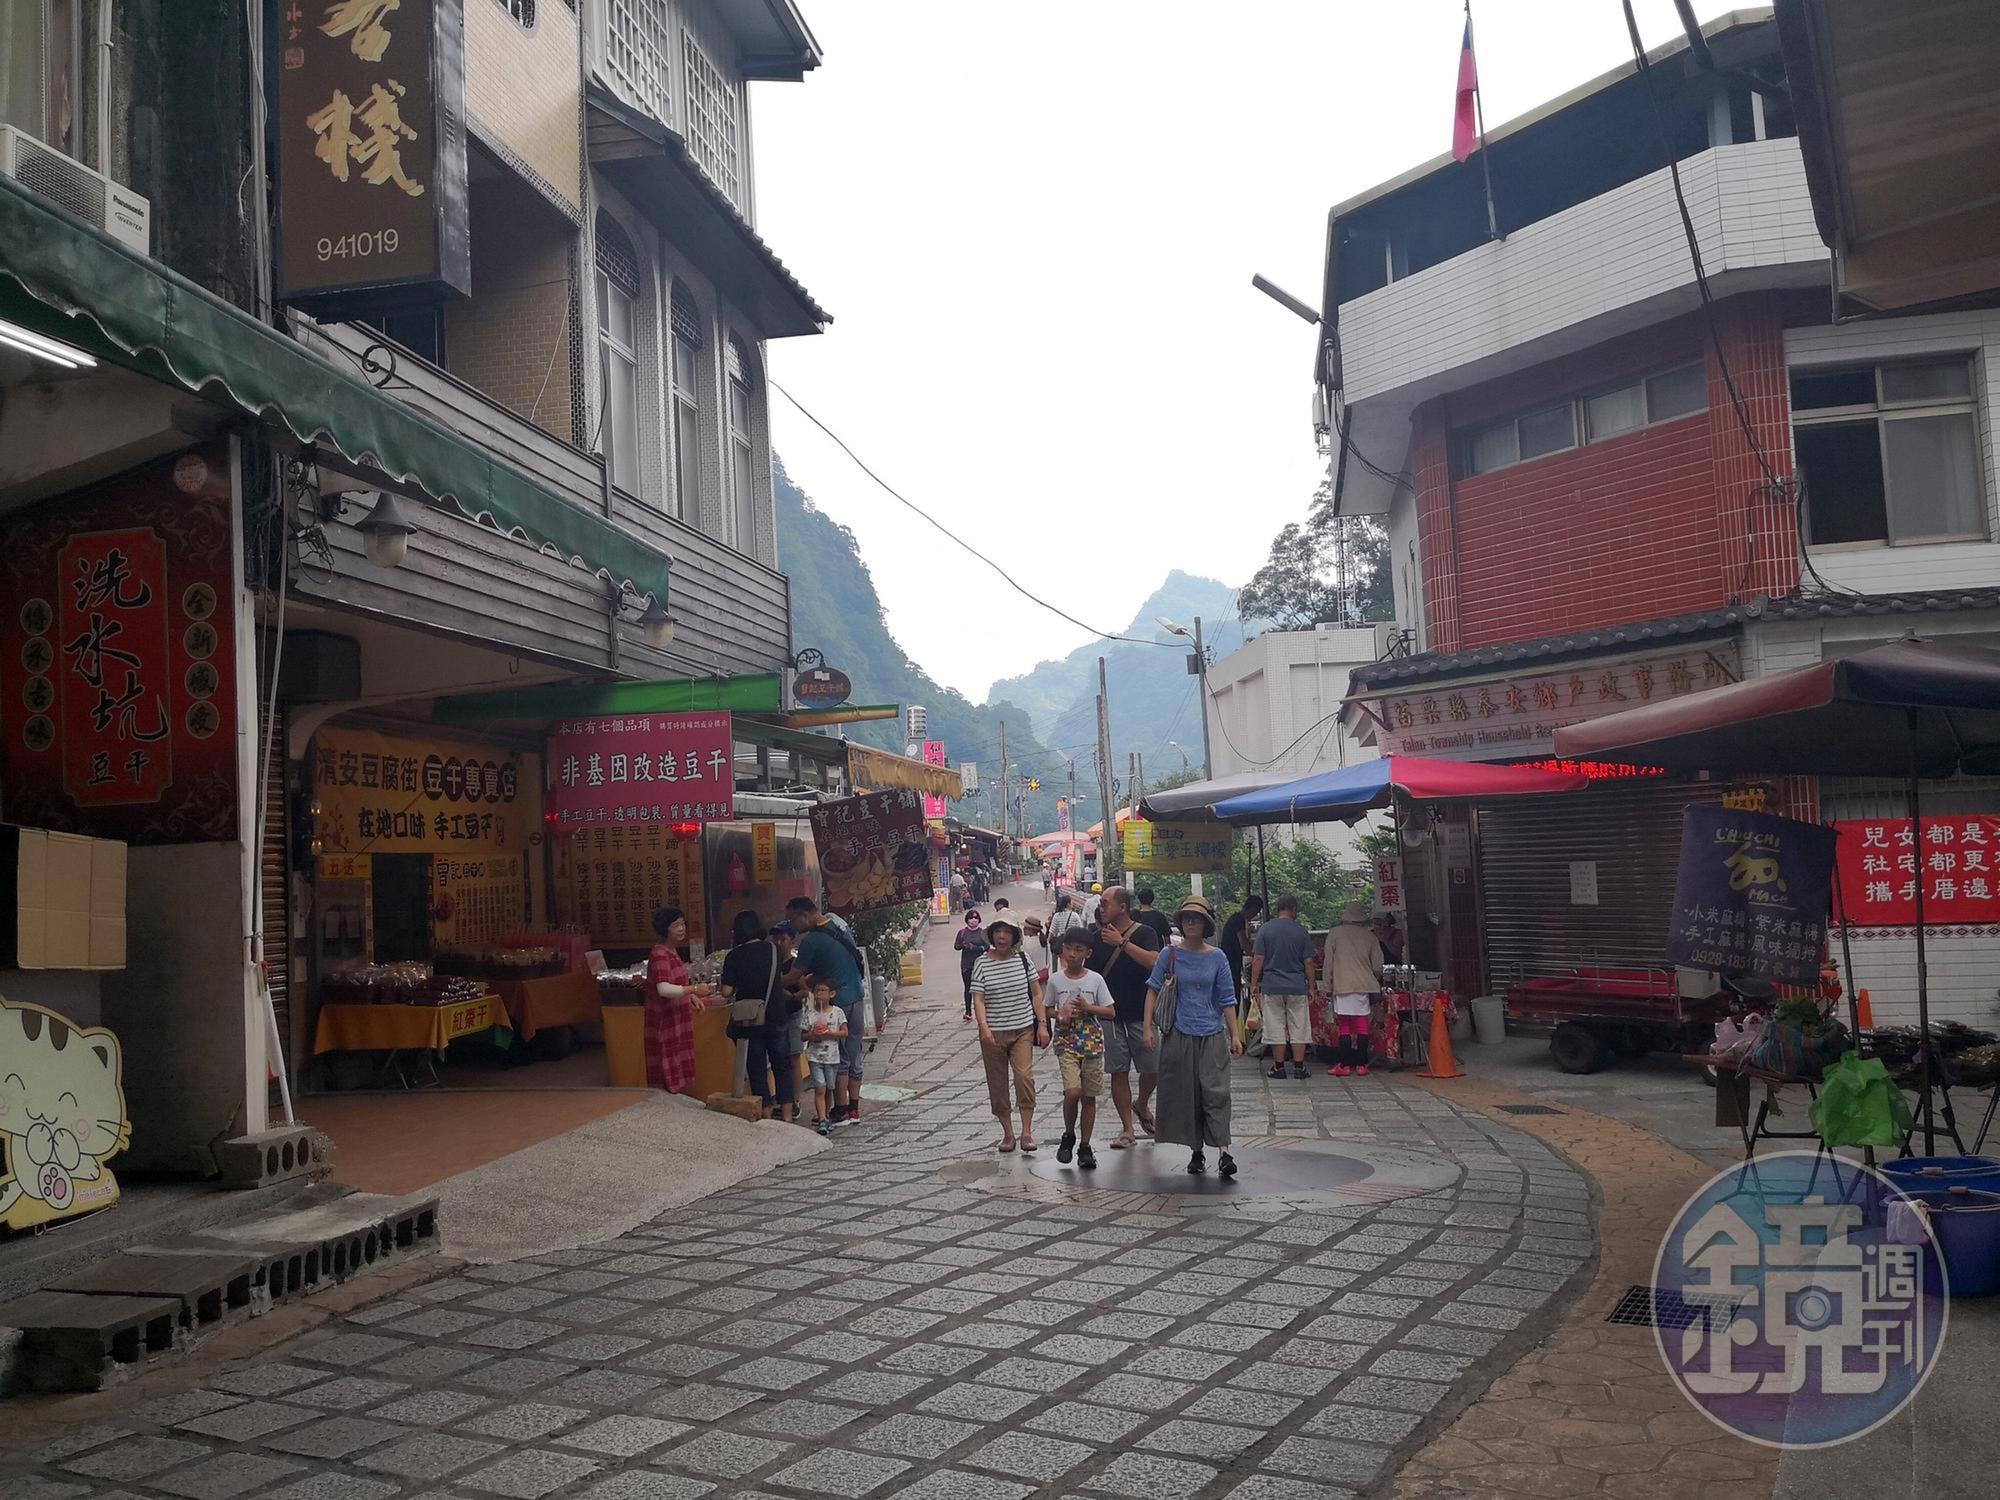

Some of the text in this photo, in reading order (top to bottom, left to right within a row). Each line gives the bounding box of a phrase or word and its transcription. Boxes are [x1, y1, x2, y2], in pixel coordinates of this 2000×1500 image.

[113, 195, 144, 218] Panasonic
[117, 214, 143, 232] INVERTER
[317, 228, 399, 261] 941019
[64, 548, 170, 741] 洗水坑
[559, 718, 651, 736] 本店有七個品項
[88, 750, 151, 785] 豆干
[318, 747, 418, 793] 清安豆腐街
[561, 748, 727, 787] 非基因改造豆干
[358, 807, 426, 840] 在地口味
[847, 823, 921, 857] 手工豆干
[1378, 861, 1400, 907] 紅棗
[1864, 876, 2000, 903] 攜手厝邊
